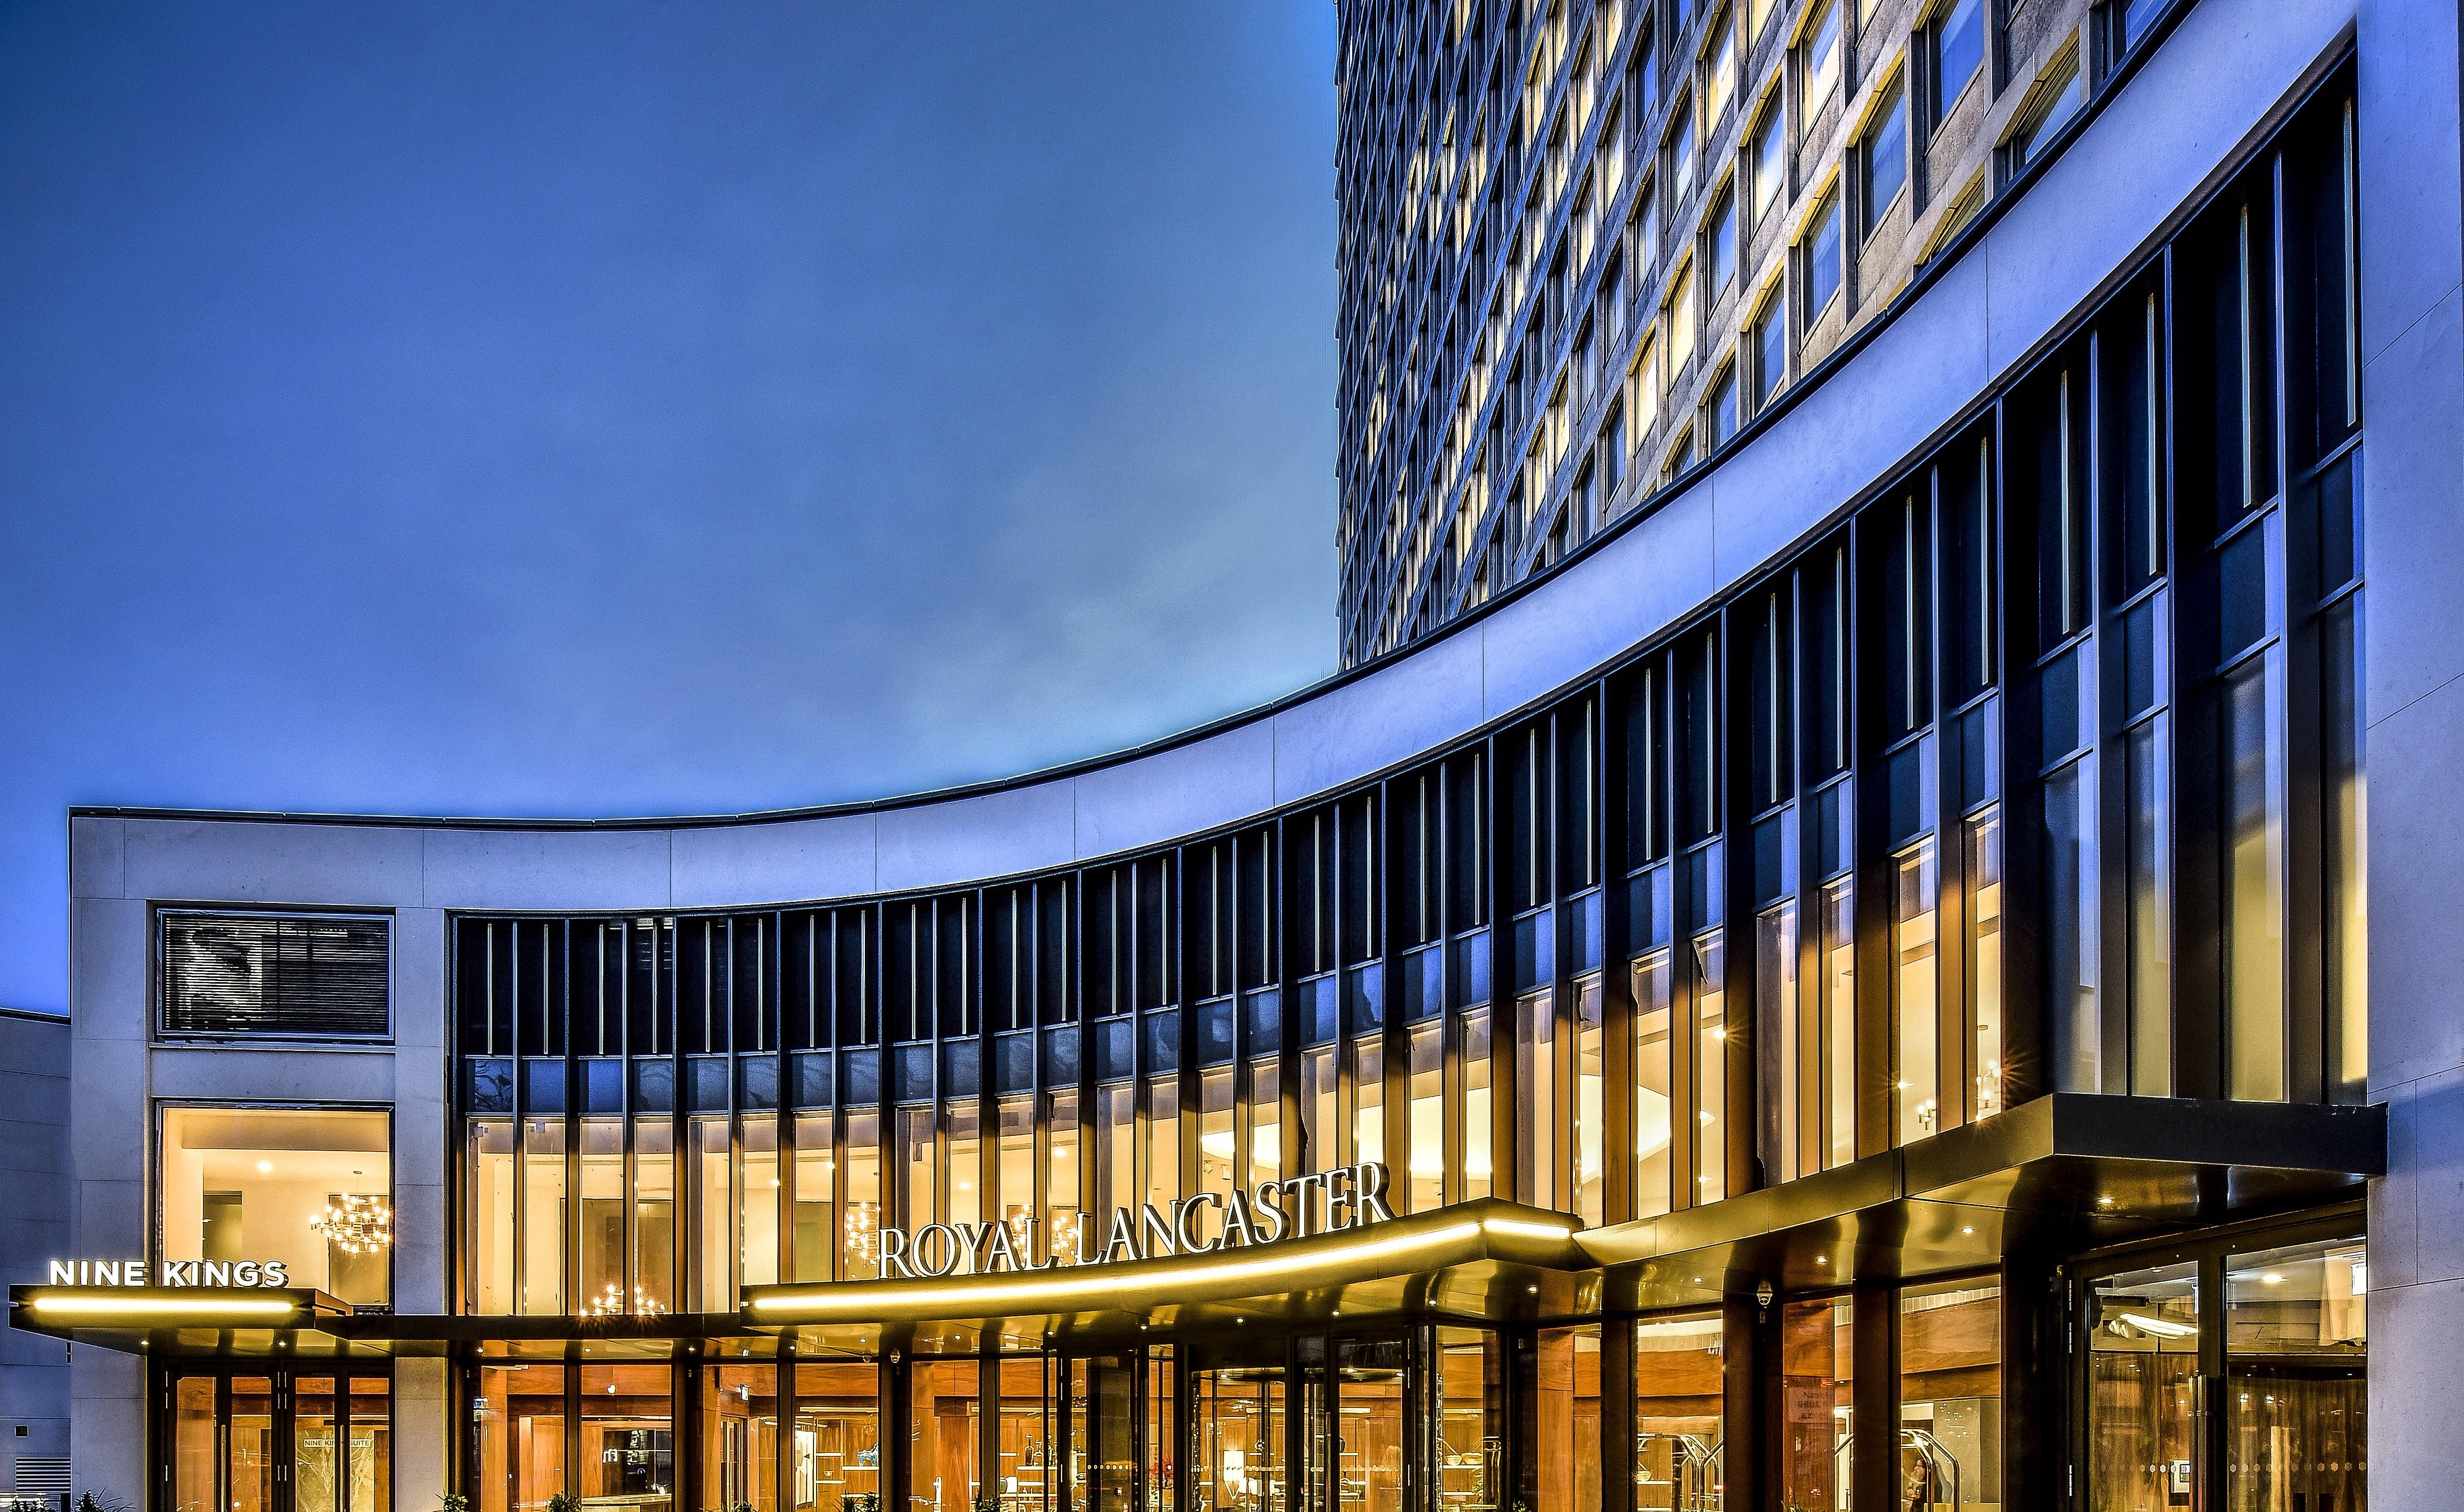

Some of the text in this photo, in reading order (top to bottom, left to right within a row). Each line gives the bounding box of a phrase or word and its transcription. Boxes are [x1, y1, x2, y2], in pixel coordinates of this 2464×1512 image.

[879, 1162, 1393, 1279] ROYAL LANCASTER
[50, 1260, 287, 1287] NINE KINGS
